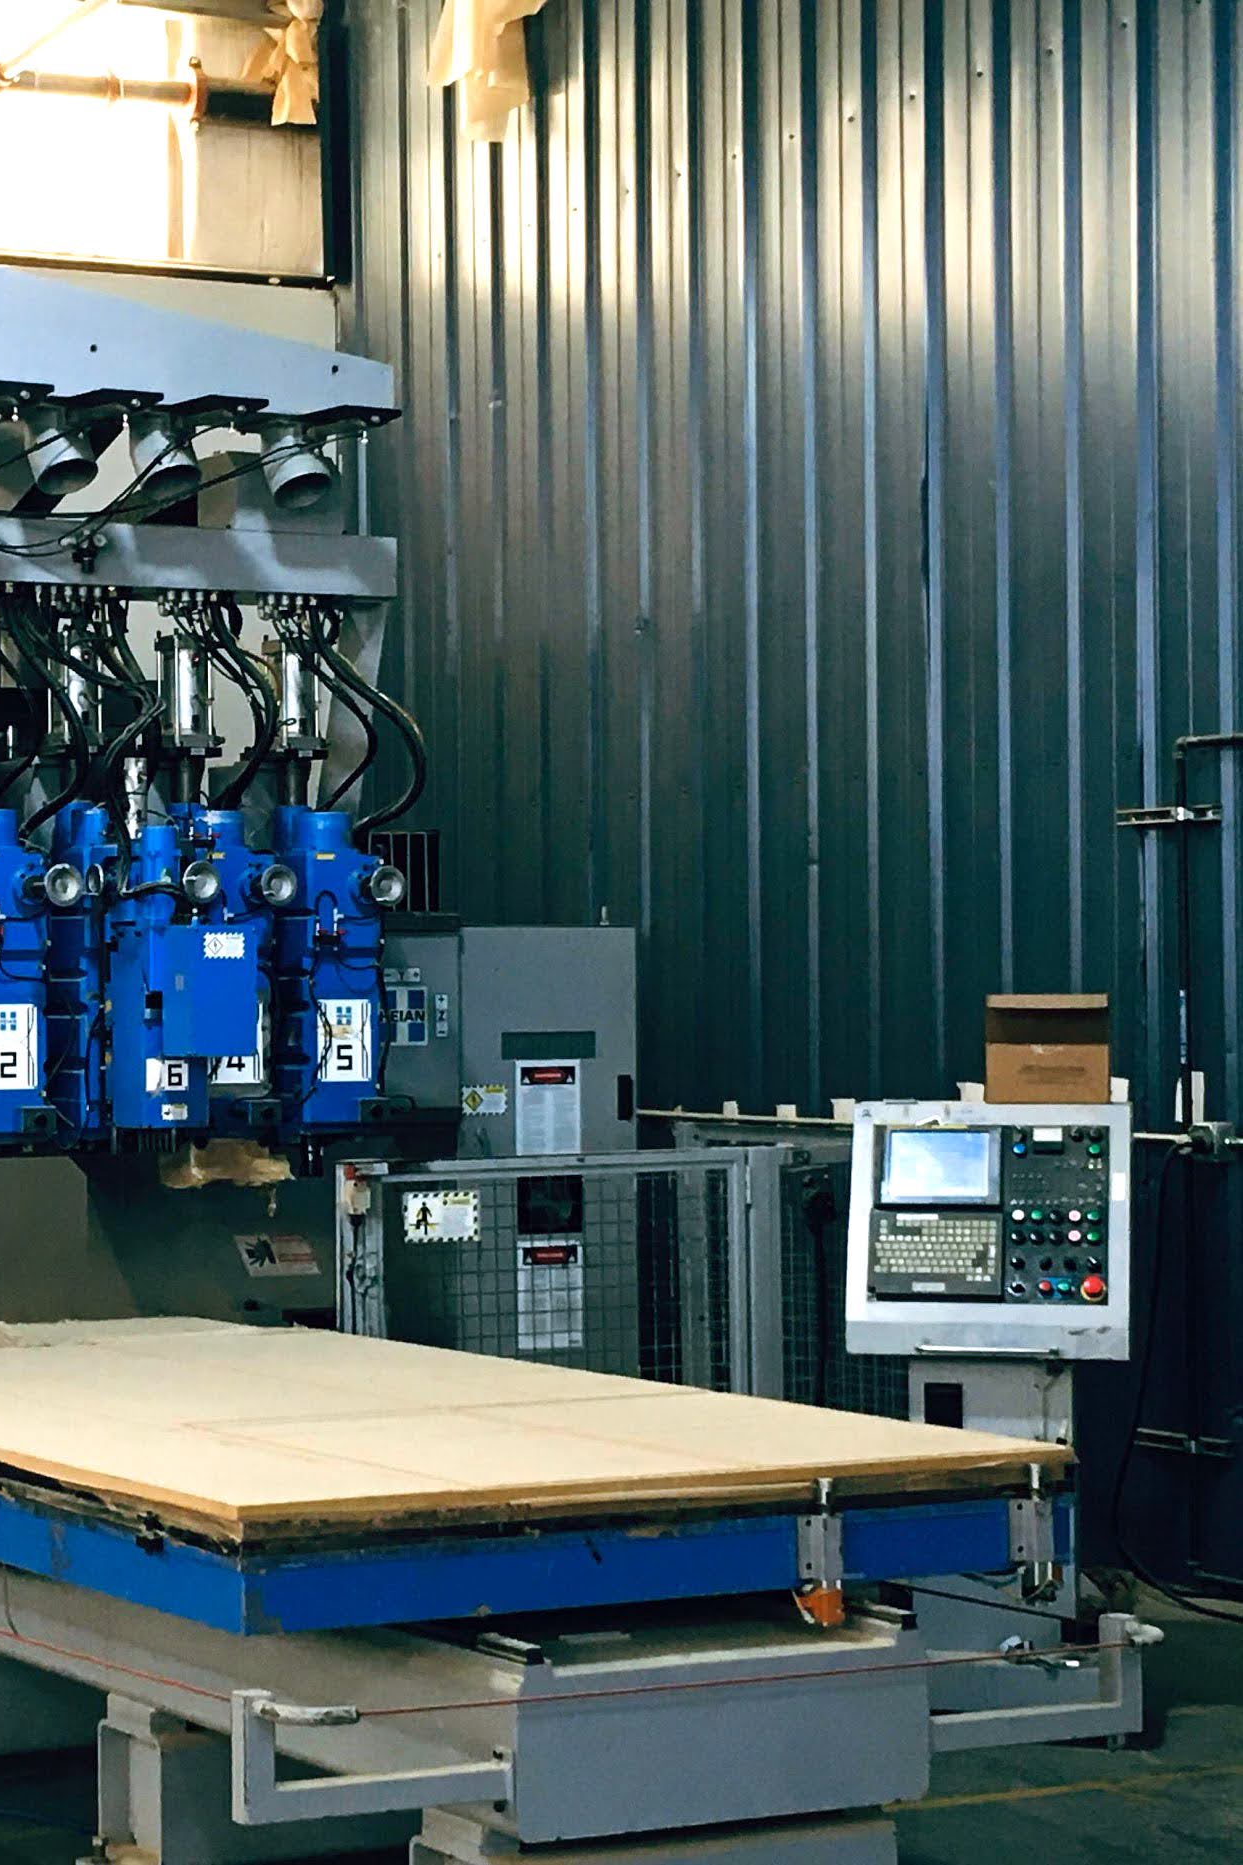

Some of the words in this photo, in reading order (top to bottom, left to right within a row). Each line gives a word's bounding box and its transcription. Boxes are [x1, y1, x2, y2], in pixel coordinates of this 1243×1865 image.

[0, 1052, 17, 1078] 2
[227, 1056, 245, 1072] 4
[337, 1045, 353, 1070] 5
[168, 1064, 182, 1086] 6
